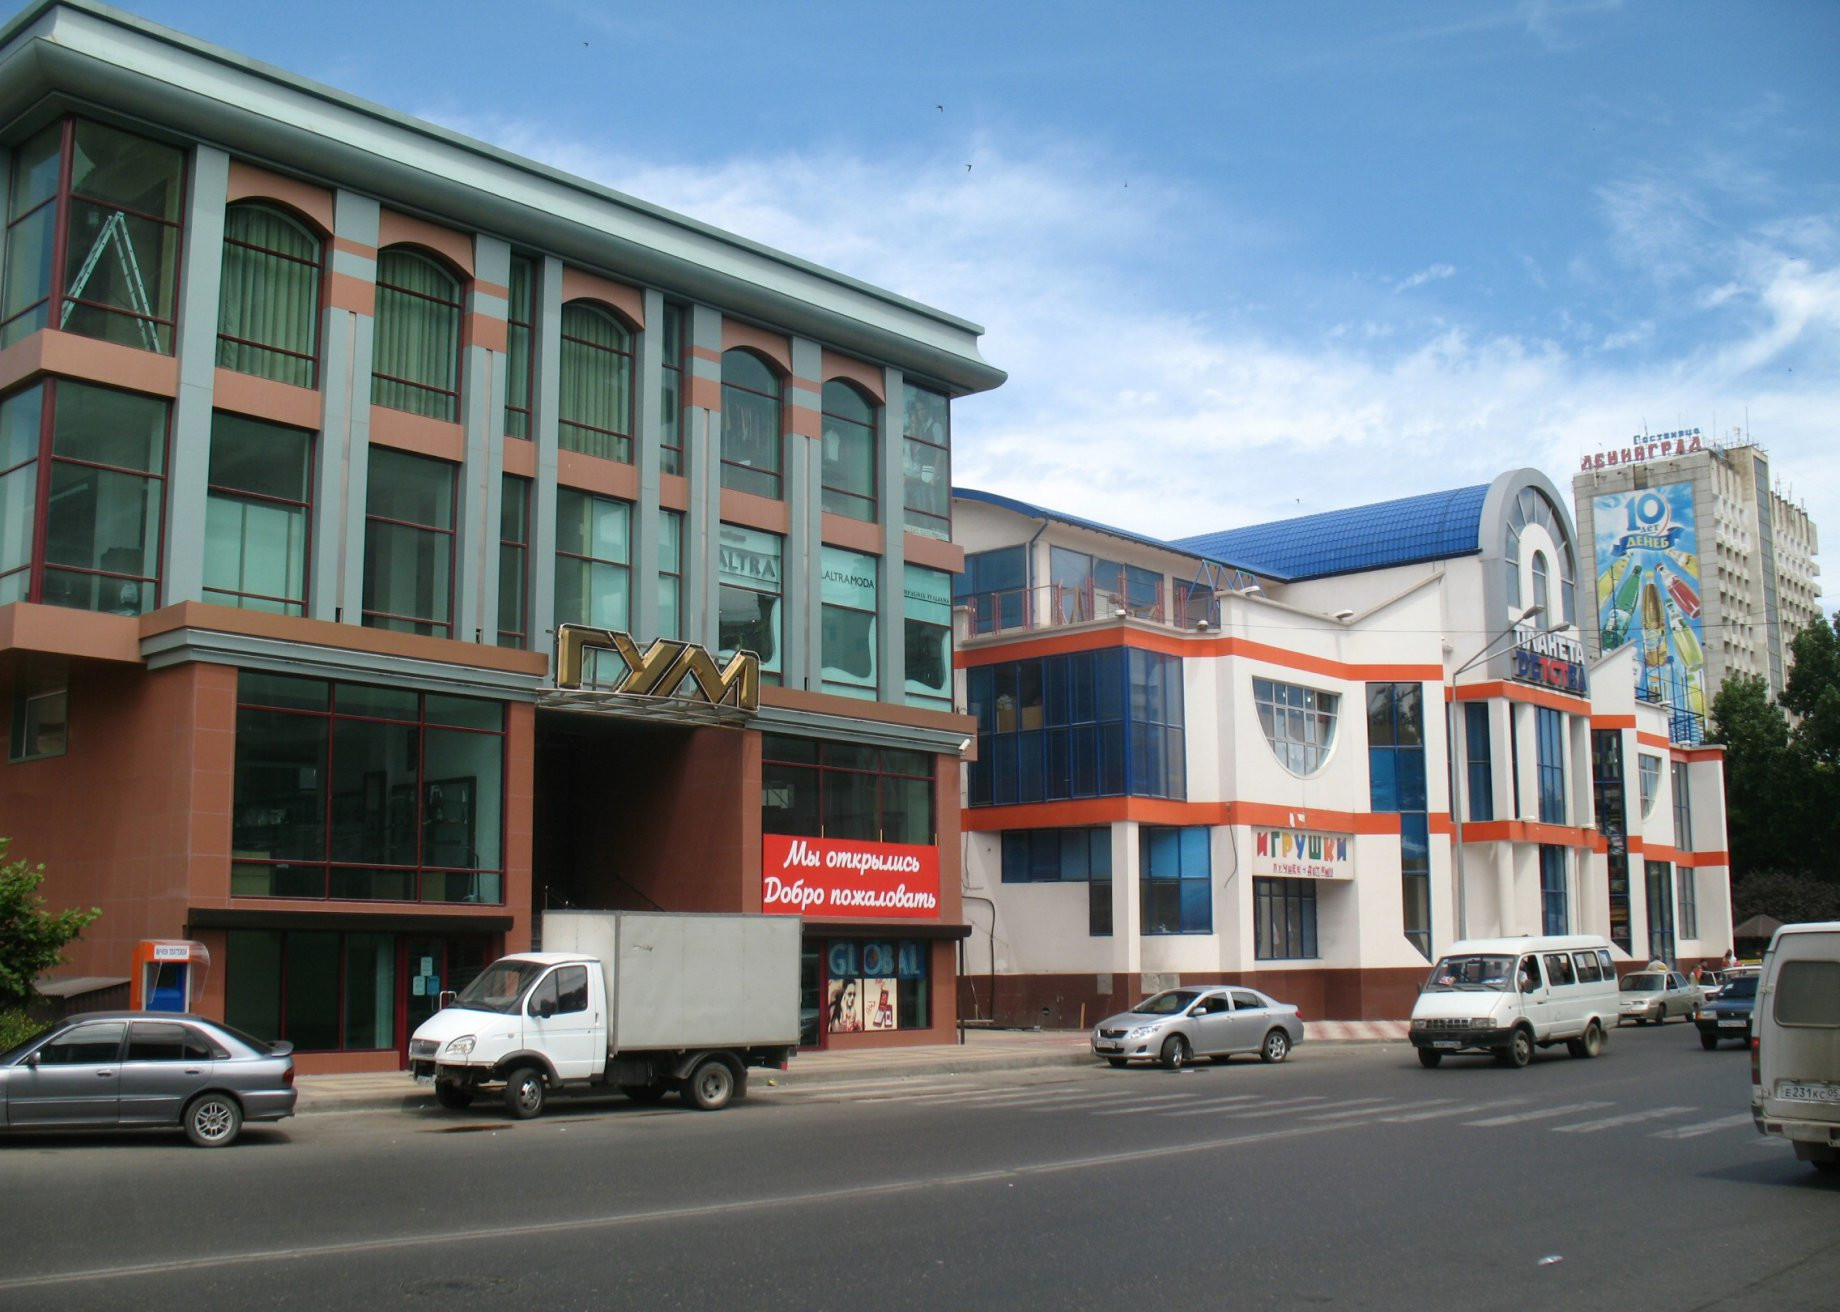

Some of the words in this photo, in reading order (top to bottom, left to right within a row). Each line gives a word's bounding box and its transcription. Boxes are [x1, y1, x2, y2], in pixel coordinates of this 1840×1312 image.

[1581, 436, 1702, 471] ЛЕНИНГРАД
[1625, 493, 1666, 531] 10
[1626, 536, 1670, 549] ДЕНЕБ
[820, 570, 875, 589] ALTRAMODA
[1513, 623, 1585, 665] ПЛАНЕТА
[558, 623, 761, 713] ГУМ
[1515, 649, 1587, 692] ДЕТСТВА
[783, 840, 821, 868] Мы
[826, 850, 920, 876] открылись
[1257, 830, 1347, 862] ИГРУШКИ
[764, 876, 825, 911] Добро
[830, 883, 936, 909] пожаловать
